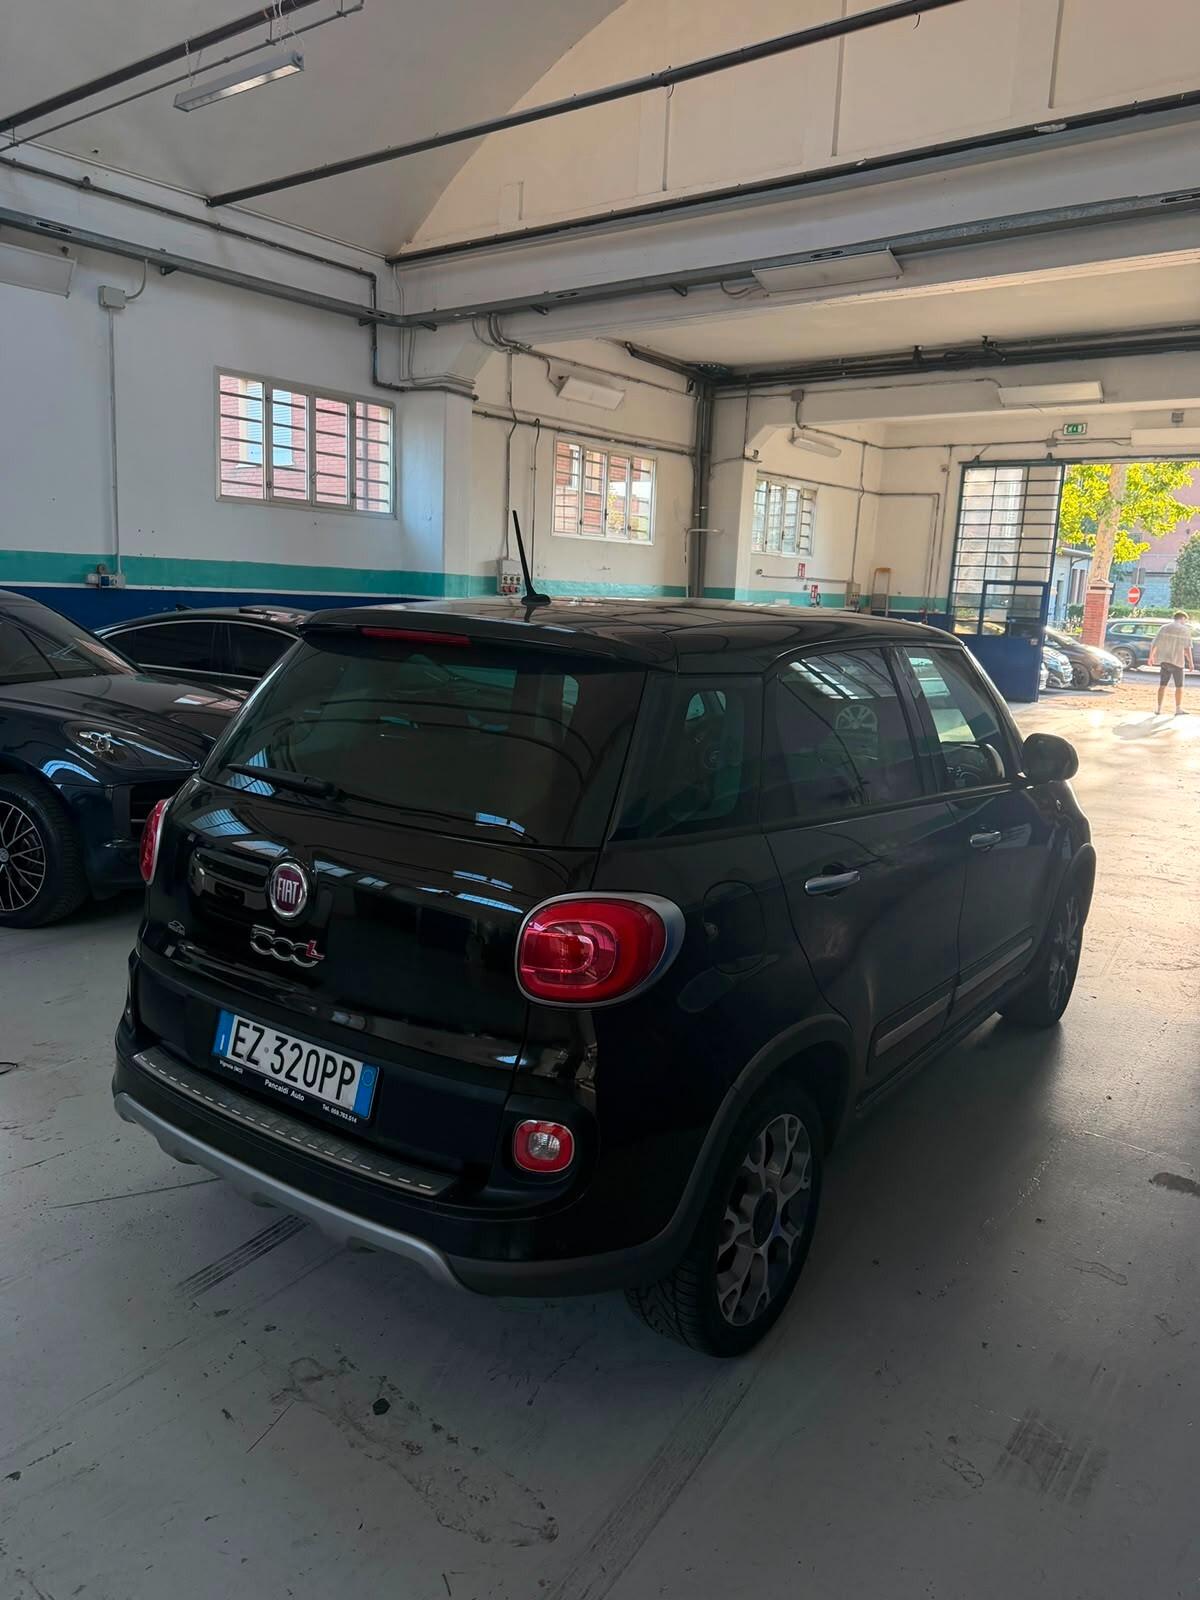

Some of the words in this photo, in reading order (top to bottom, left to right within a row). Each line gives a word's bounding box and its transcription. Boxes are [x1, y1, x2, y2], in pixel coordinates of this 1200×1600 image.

[277, 877, 299, 905] FIAT
[264, 1078, 289, 1095] Pancaldi
[290, 1089, 305, 1102] Auto
